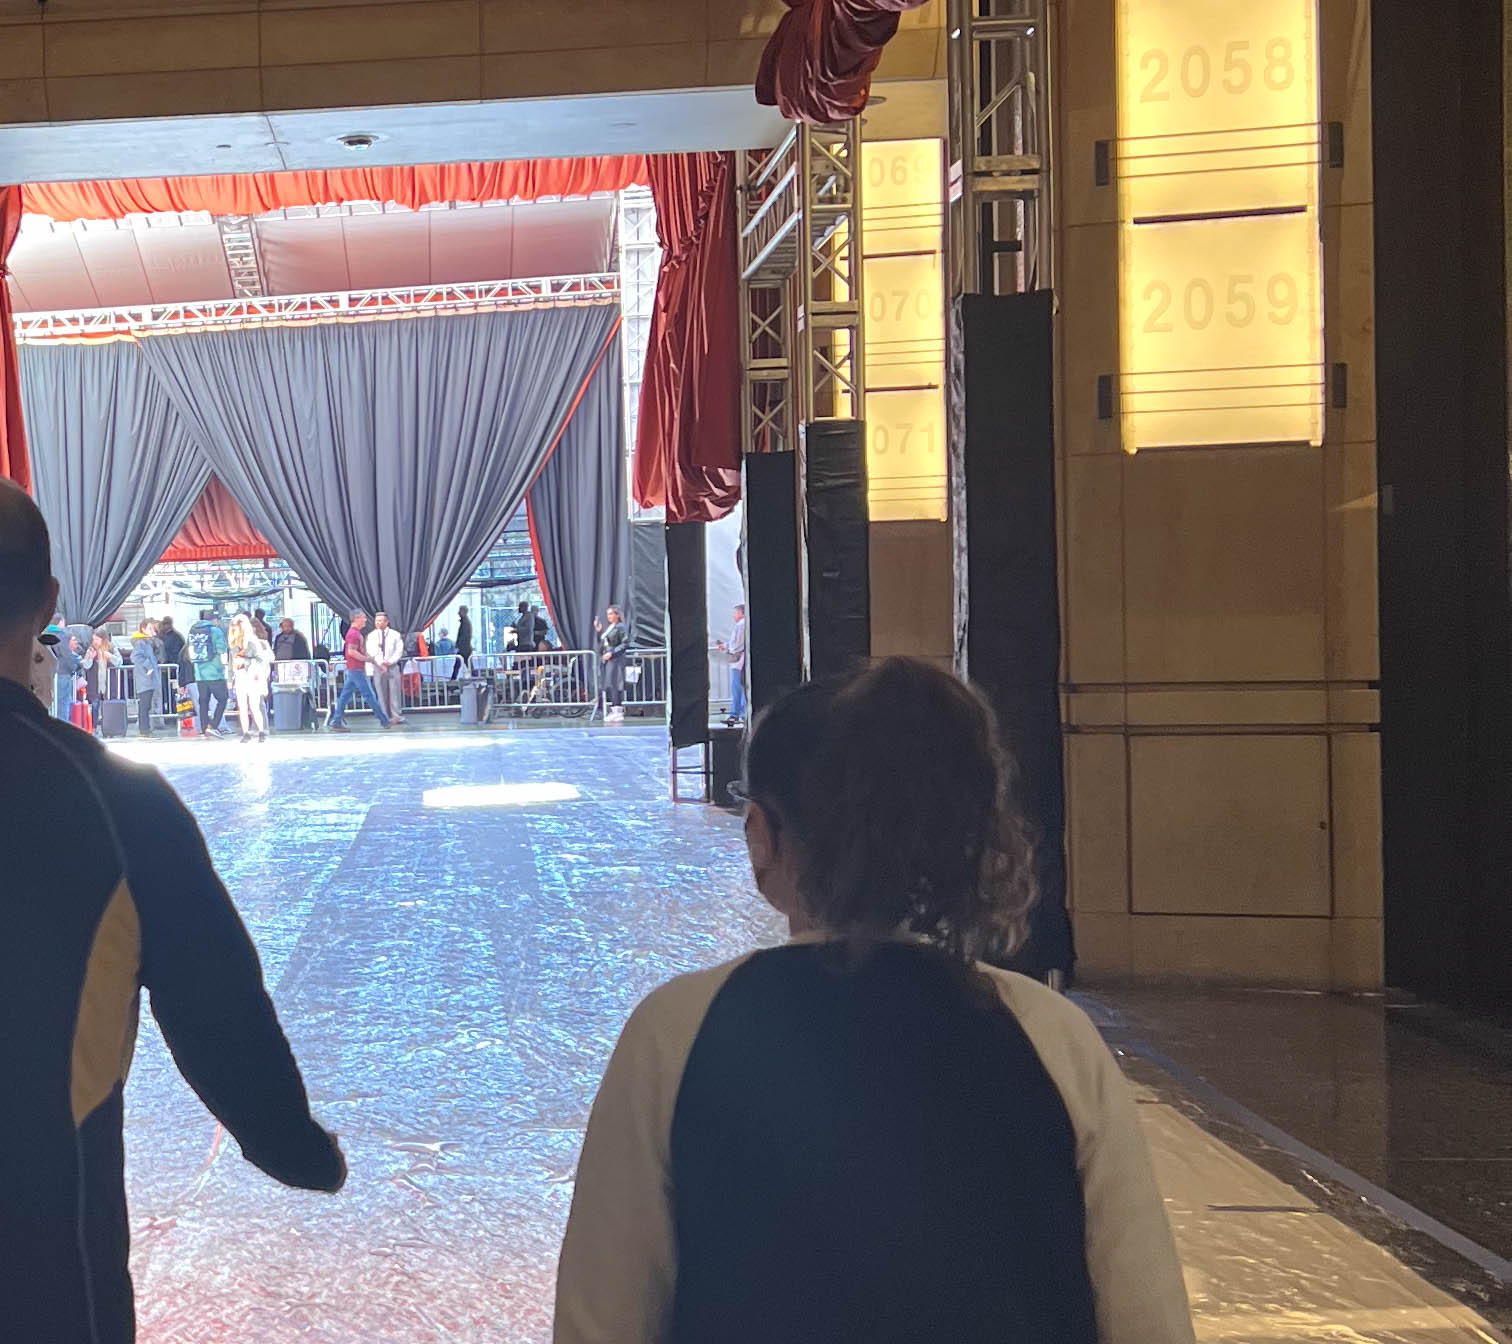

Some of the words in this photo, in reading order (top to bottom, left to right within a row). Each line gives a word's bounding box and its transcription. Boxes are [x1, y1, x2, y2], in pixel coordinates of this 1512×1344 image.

[1137, 35, 1296, 104] 2058
[867, 153, 934, 188] 069
[869, 288, 933, 323] 070
[1140, 271, 1299, 335] 2059
[871, 421, 937, 456] 071
